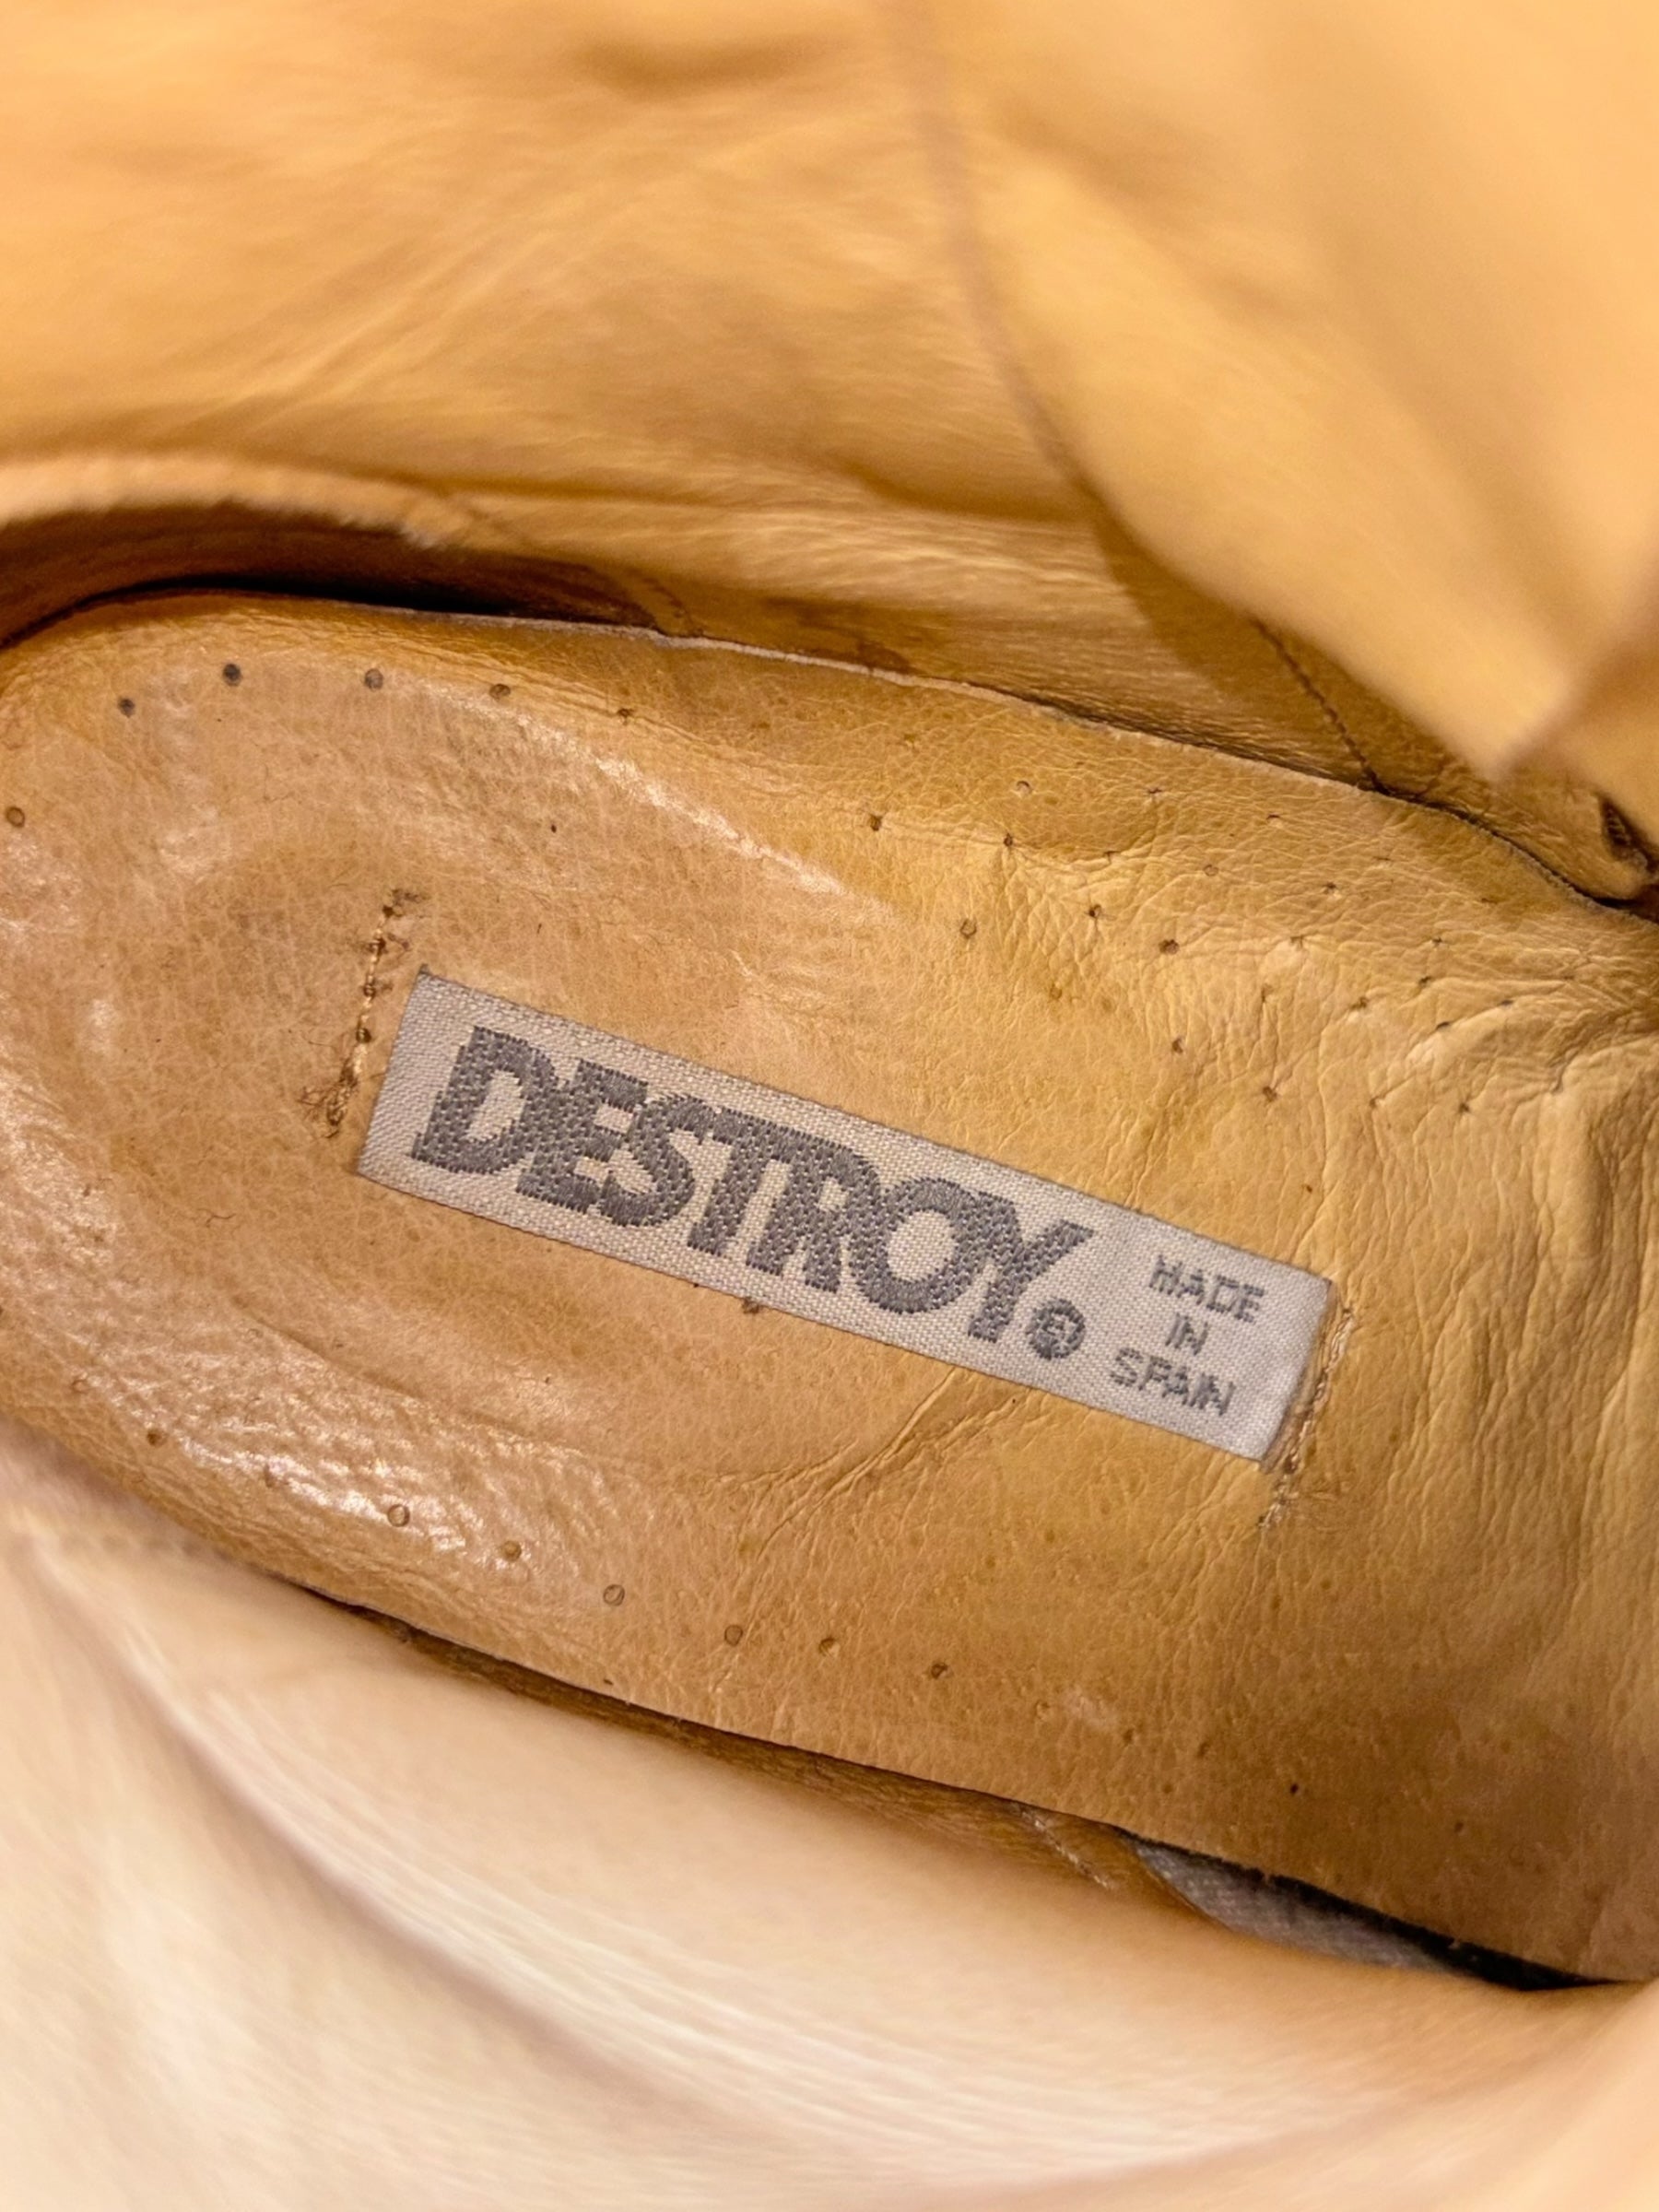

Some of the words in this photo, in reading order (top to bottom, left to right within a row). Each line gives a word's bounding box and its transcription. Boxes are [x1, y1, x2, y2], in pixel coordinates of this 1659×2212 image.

[411, 1026, 1094, 1343] DESTROY
[1148, 1254, 1265, 1324] MADE
[1164, 1312, 1208, 1356] IN
[1110, 1347, 1235, 1416] SPAIN
